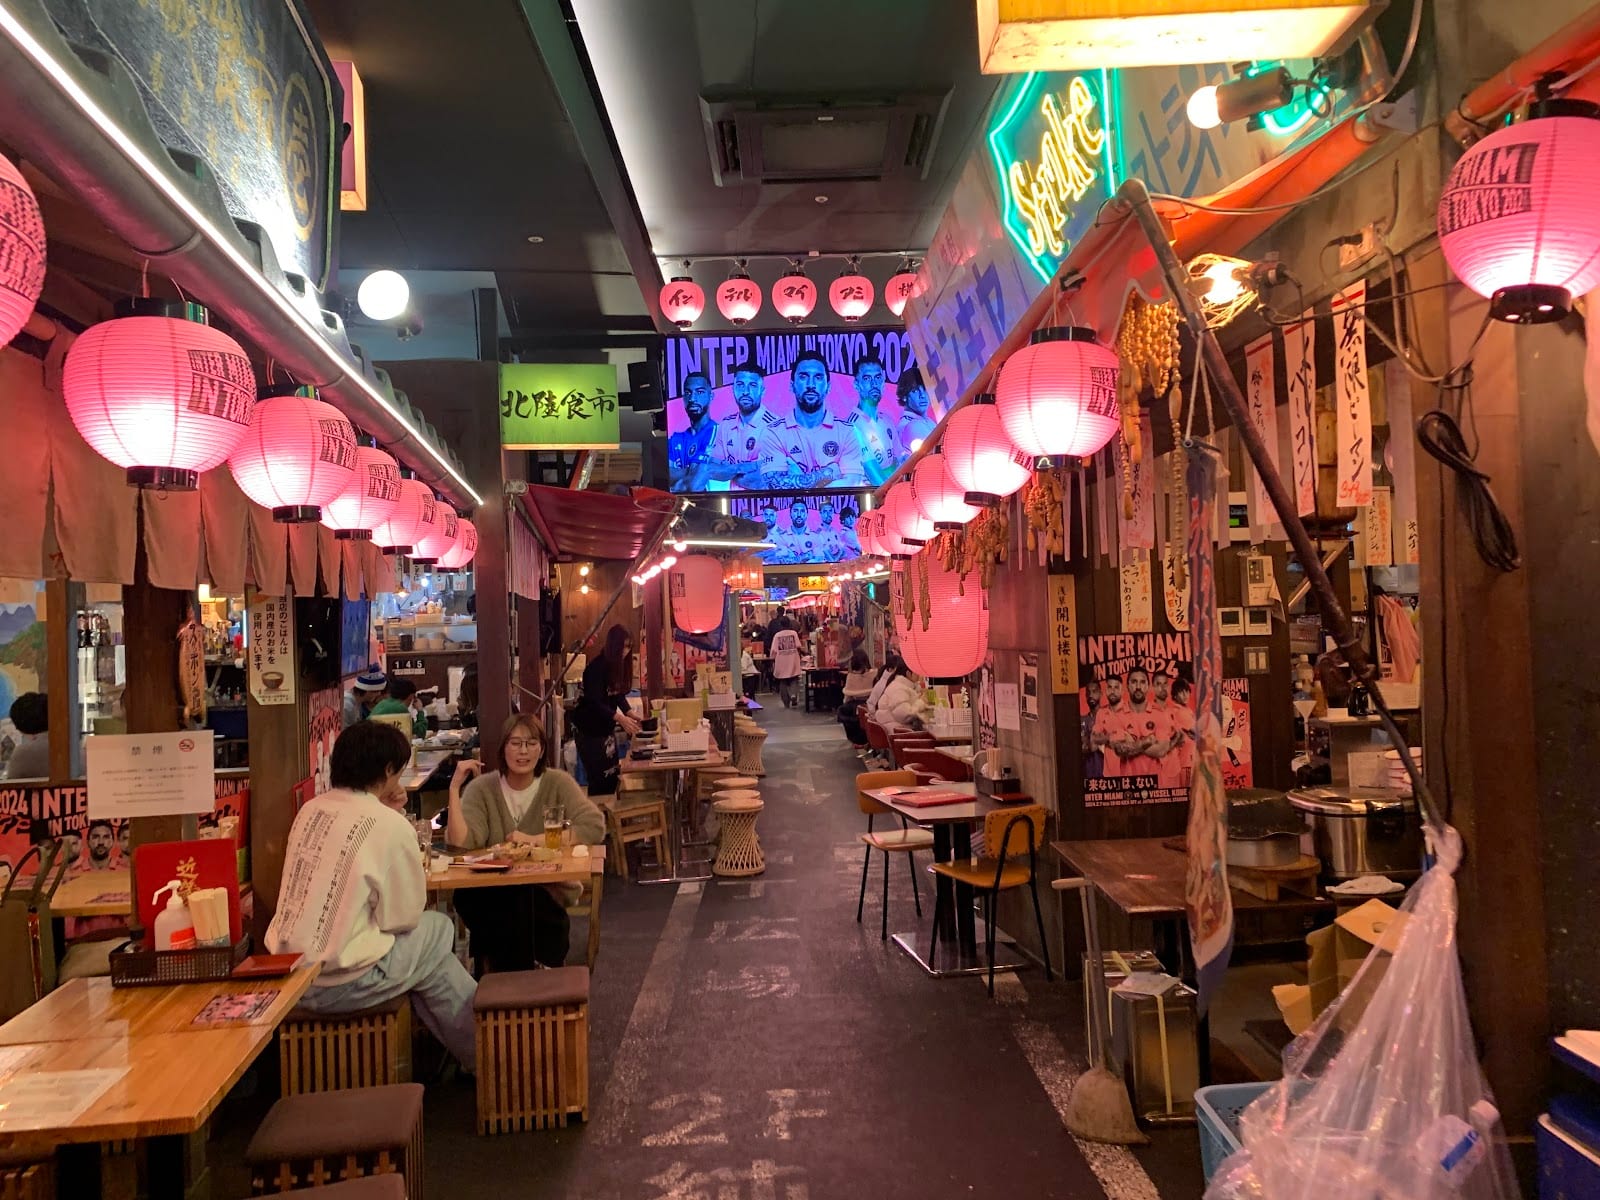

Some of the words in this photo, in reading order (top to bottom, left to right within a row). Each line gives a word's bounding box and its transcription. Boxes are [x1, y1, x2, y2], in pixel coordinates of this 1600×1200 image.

[669, 288, 693, 306] イン
[667, 337, 749, 398] INTER
[756, 335, 799, 374] MIAMI
[818, 333, 867, 374] TOKYO
[873, 332, 915, 383] 202
[501, 388, 616, 421] 北陸食市
[1079, 634, 1134, 665] INTER
[1137, 633, 1192, 663] MIAMI
[1094, 663, 1106, 681] IN
[1107, 656, 1136, 676] TOKYO
[1137, 655, 1180, 679] 2024
[0, 788, 28, 816] 024
[31, 786, 87, 820] INTE
[1085, 793, 1103, 802] INTER
[1104, 792, 1124, 801] MIAMI
[1149, 790, 1170, 799] VISSEL
[48, 819, 63, 837] IN
[64, 812, 90, 831] TOK
